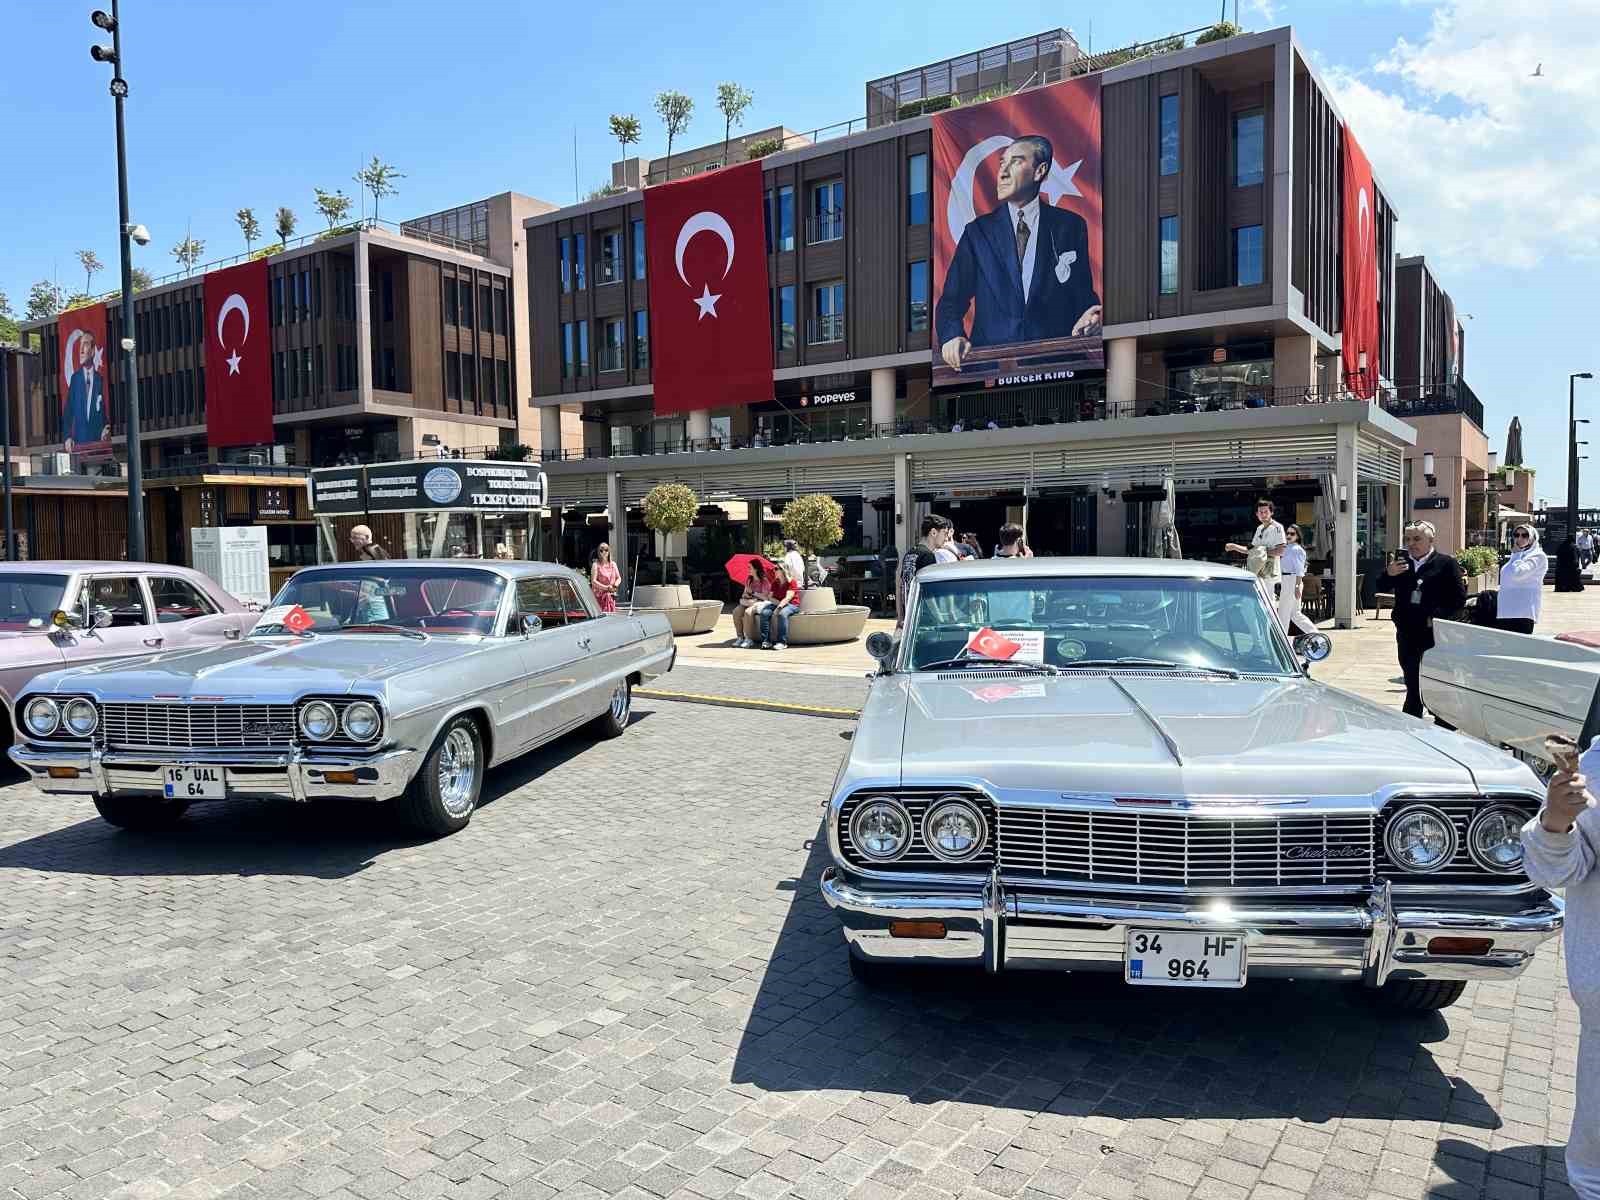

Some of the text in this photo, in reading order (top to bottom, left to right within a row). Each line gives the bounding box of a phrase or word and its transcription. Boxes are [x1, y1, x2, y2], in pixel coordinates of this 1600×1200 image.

[471, 493, 508, 504] TICKET
[168, 768, 219, 782] 16 UAL
[187, 783, 204, 795] 64
[1135, 934, 1238, 956] 34 HF
[1168, 959, 1209, 979] 964
